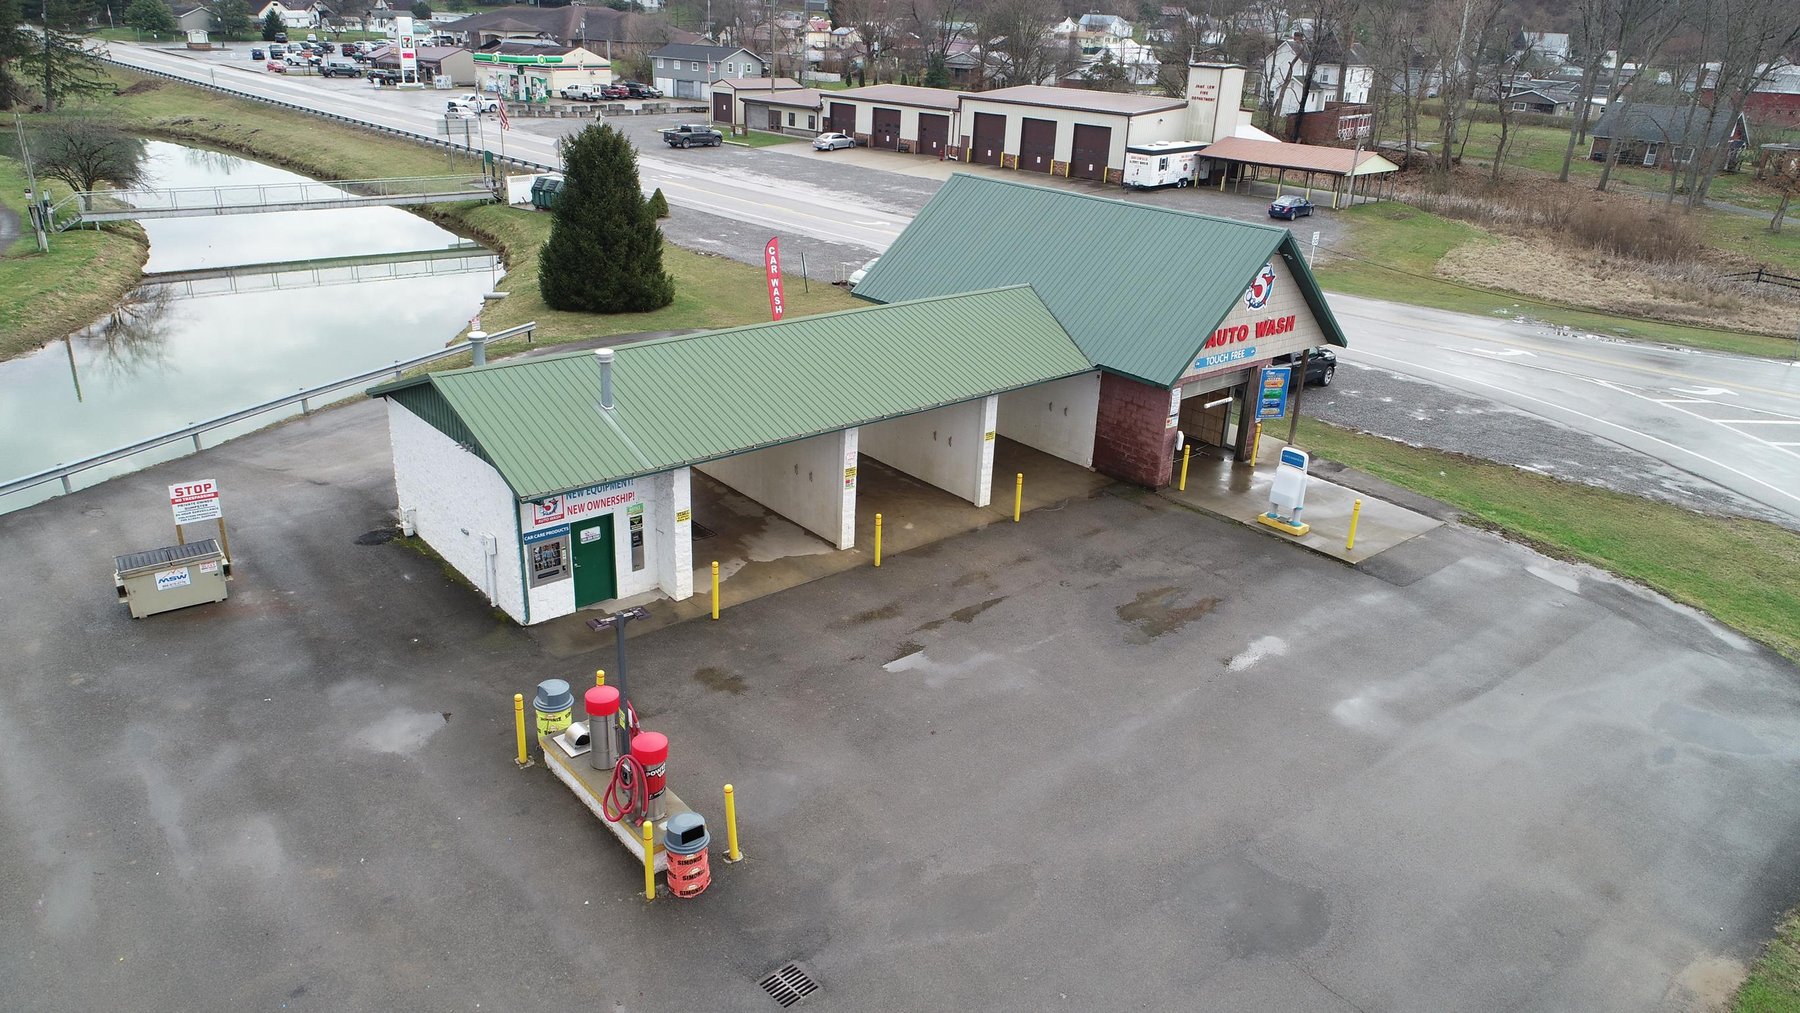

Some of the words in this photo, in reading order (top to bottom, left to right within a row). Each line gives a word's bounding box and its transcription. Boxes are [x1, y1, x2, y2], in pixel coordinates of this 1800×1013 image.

[769, 247, 778, 274] CAR
[771, 278, 782, 313] WASH
[1205, 325, 1249, 349] AUTO
[1255, 315, 1296, 338] WASH
[1206, 353, 1229, 366] TOUCH
[1230, 350, 1246, 360] FREE
[175, 483, 212, 497] STOP
[566, 490, 585, 500] NEW
[586, 480, 634, 496] EQUIPMENT!
[567, 504, 585, 516] NEW
[587, 492, 635, 511] OWNERSHIP!
[545, 526, 570, 536] PRODUCTS
[158, 574, 187, 584] MSW
